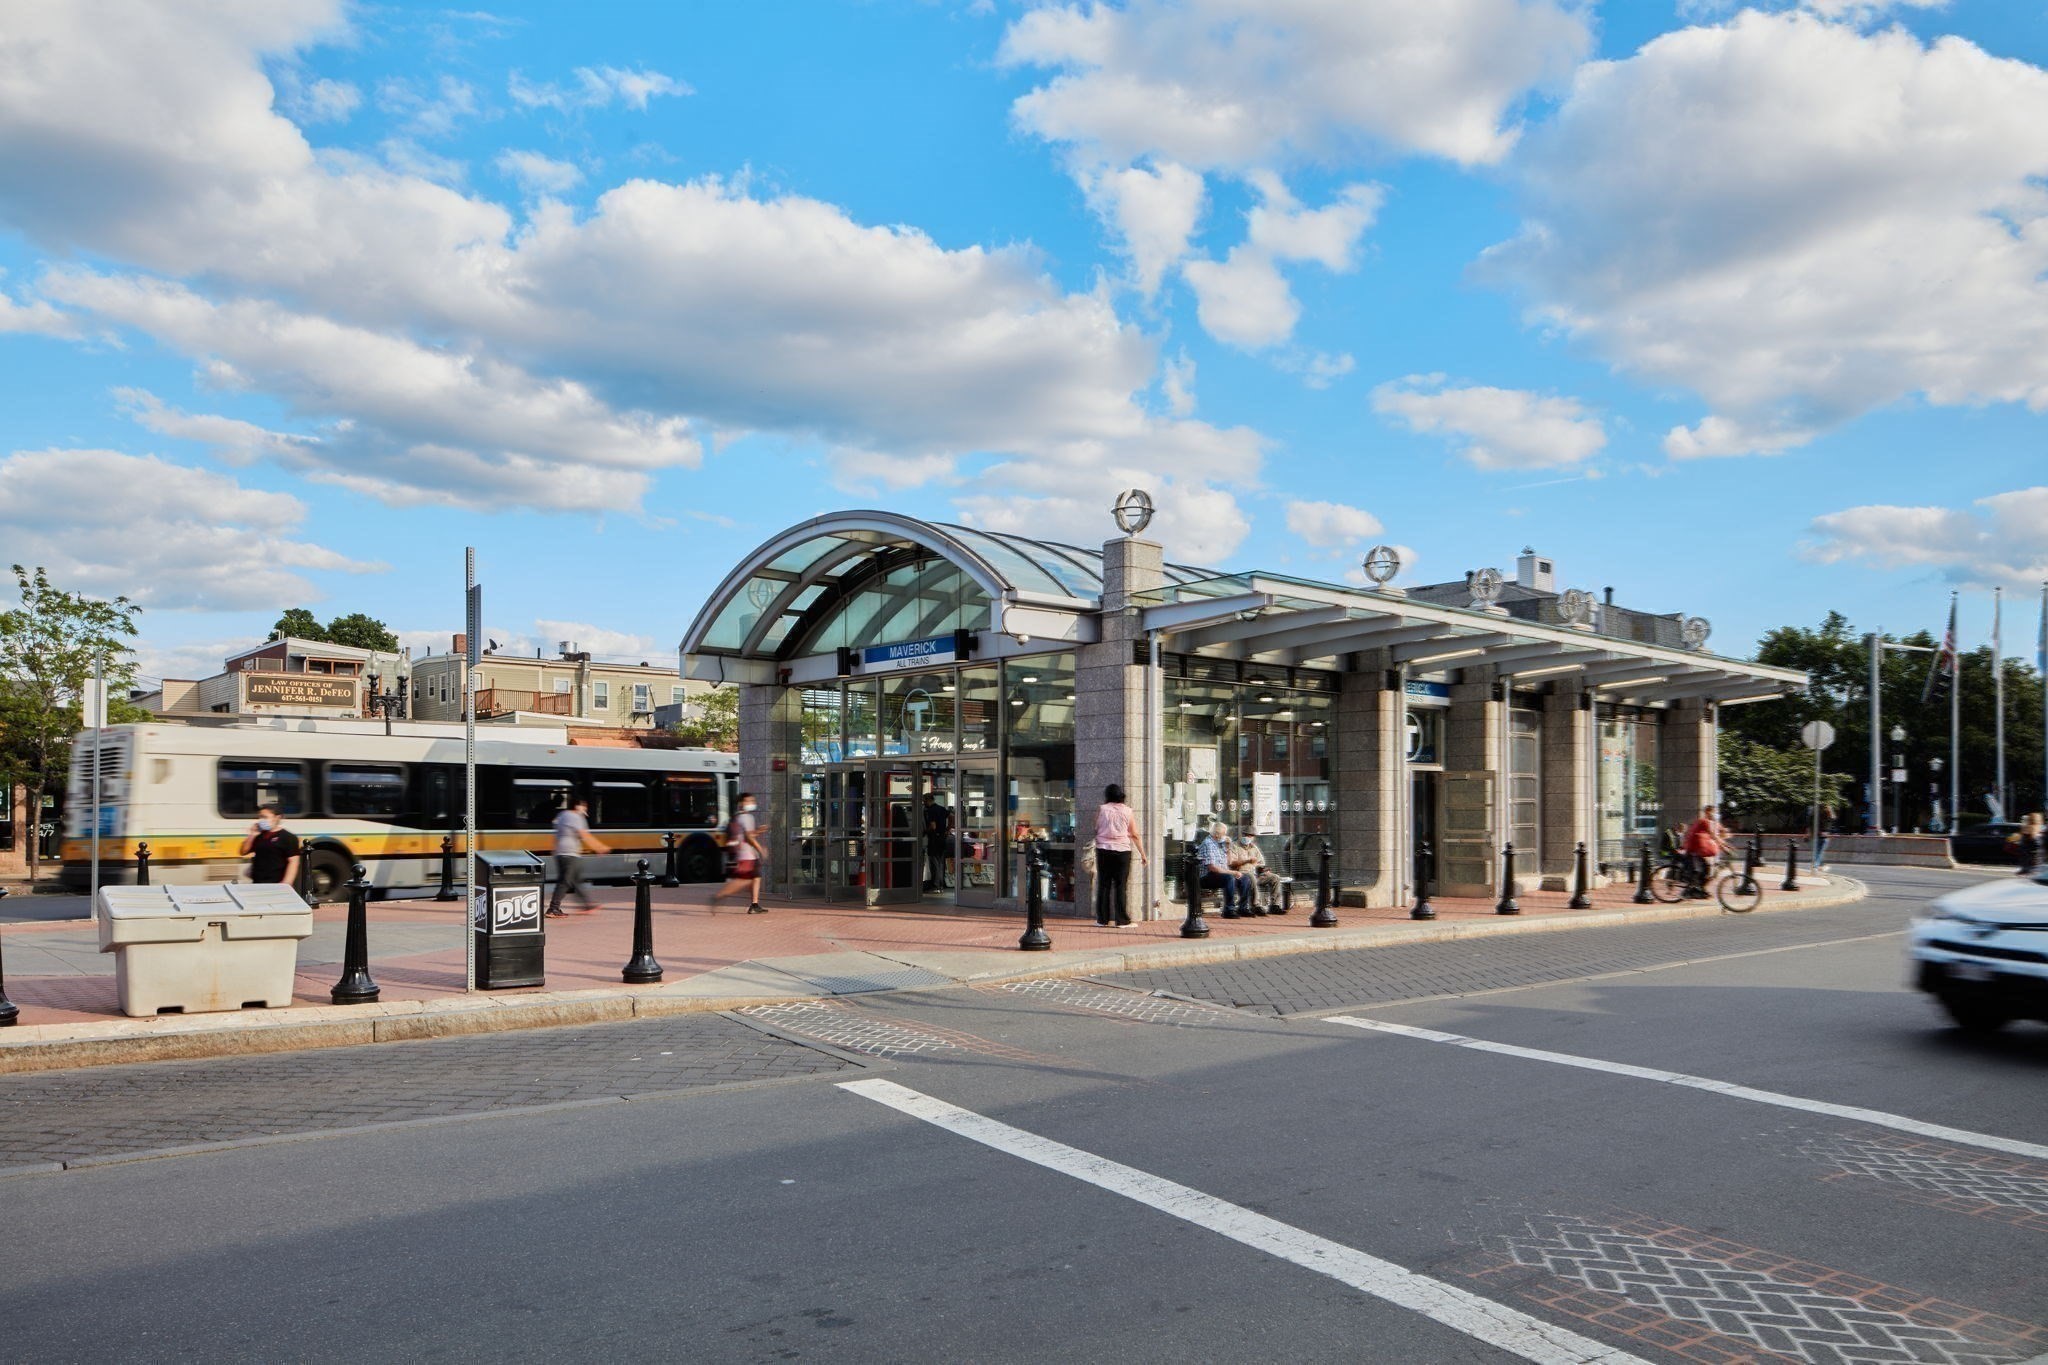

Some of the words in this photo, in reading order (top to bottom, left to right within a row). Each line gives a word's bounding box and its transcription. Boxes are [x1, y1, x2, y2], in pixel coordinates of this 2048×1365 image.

[889, 641, 936, 658] MAVERICK
[896, 660, 906, 668] ALL
[908, 656, 929, 667] TRAINS
[251, 684, 304, 695] JENNIFER
[307, 687, 317, 696] R.
[320, 688, 351, 697] DeFEO
[281, 694, 322, 703] 617-561-0151
[906, 701, 929, 732] T
[928, 736, 953, 752] Hong
[962, 738, 978, 750] ong
[496, 893, 537, 922] DIG
